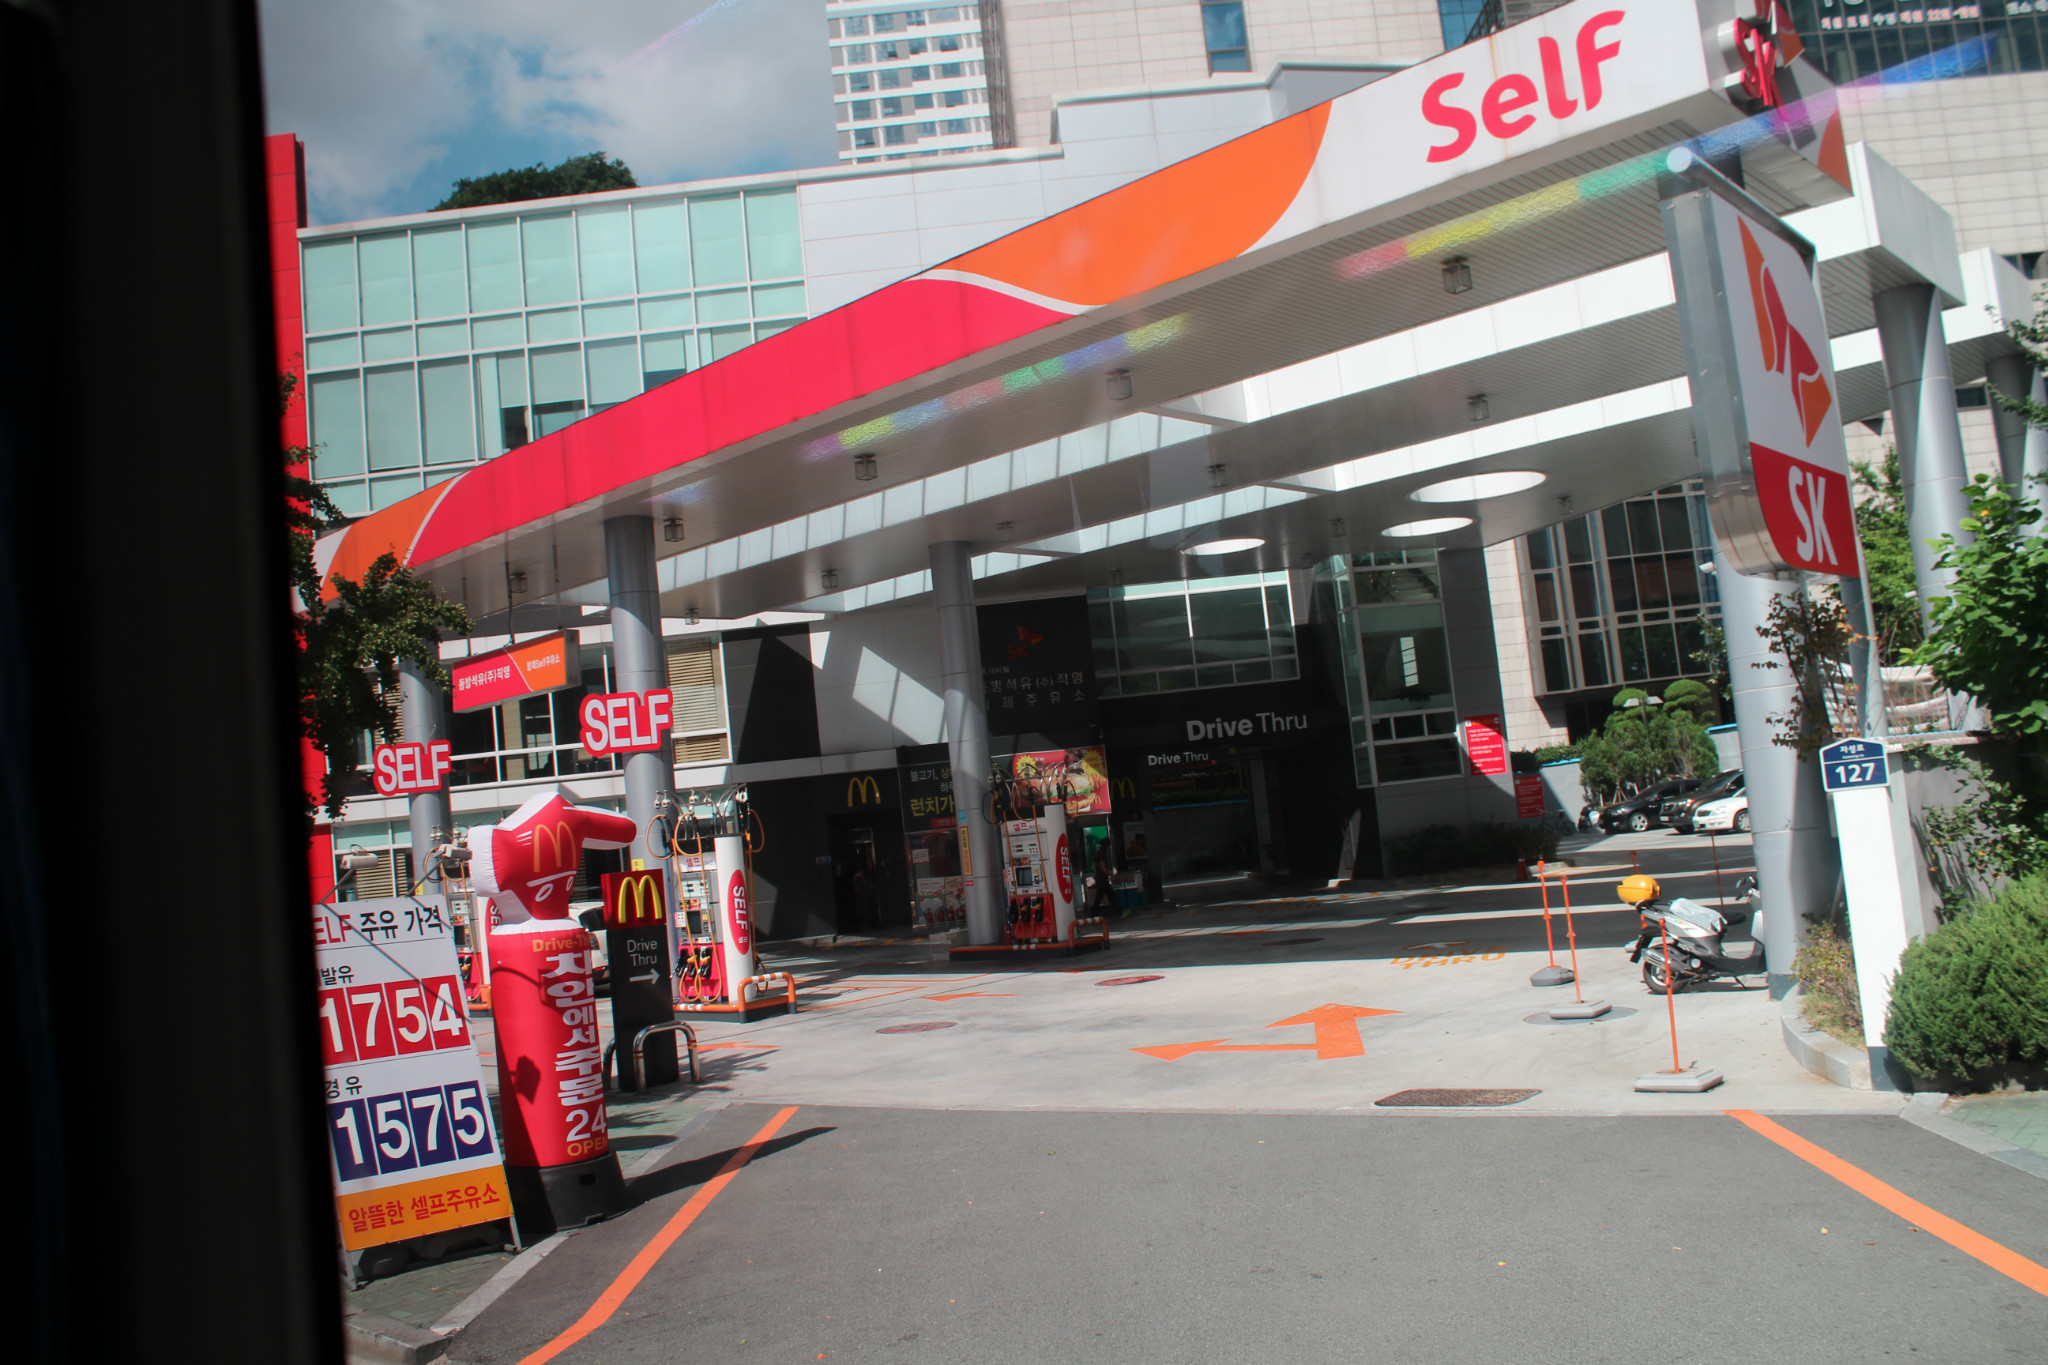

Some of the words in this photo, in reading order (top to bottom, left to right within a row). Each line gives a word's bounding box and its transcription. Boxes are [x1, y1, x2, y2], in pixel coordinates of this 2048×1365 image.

[1421, 10, 1626, 163] Self
[1788, 466, 1838, 566] SK
[1006, 643, 1029, 659] SK
[458, 665, 511, 691] 동방석유(주)직영
[583, 694, 669, 752] SELF
[1186, 717, 1254, 742] Drive
[1255, 711, 1307, 734] Thru
[377, 743, 449, 793] SELF
[1147, 754, 1181, 766] Drive
[1183, 751, 1209, 763] Thru
[1835, 762, 1875, 784] 127
[1060, 846, 1071, 885] SELF
[313, 913, 352, 945] ELF
[360, 910, 398, 941] 주유
[404, 905, 444, 936] 가격
[733, 885, 748, 931] SELF
[627, 938, 658, 953] Drive
[629, 954, 657, 967] Thru
[1400, 953, 1506, 970] THRU
[316, 965, 354, 987] 발유
[319, 983, 464, 1054] 1754
[335, 1086, 486, 1166] 1575
[566, 1104, 607, 1143] 24
[348, 1199, 404, 1234] 알뜰한
[411, 1182, 500, 1219] 셀프주유소
